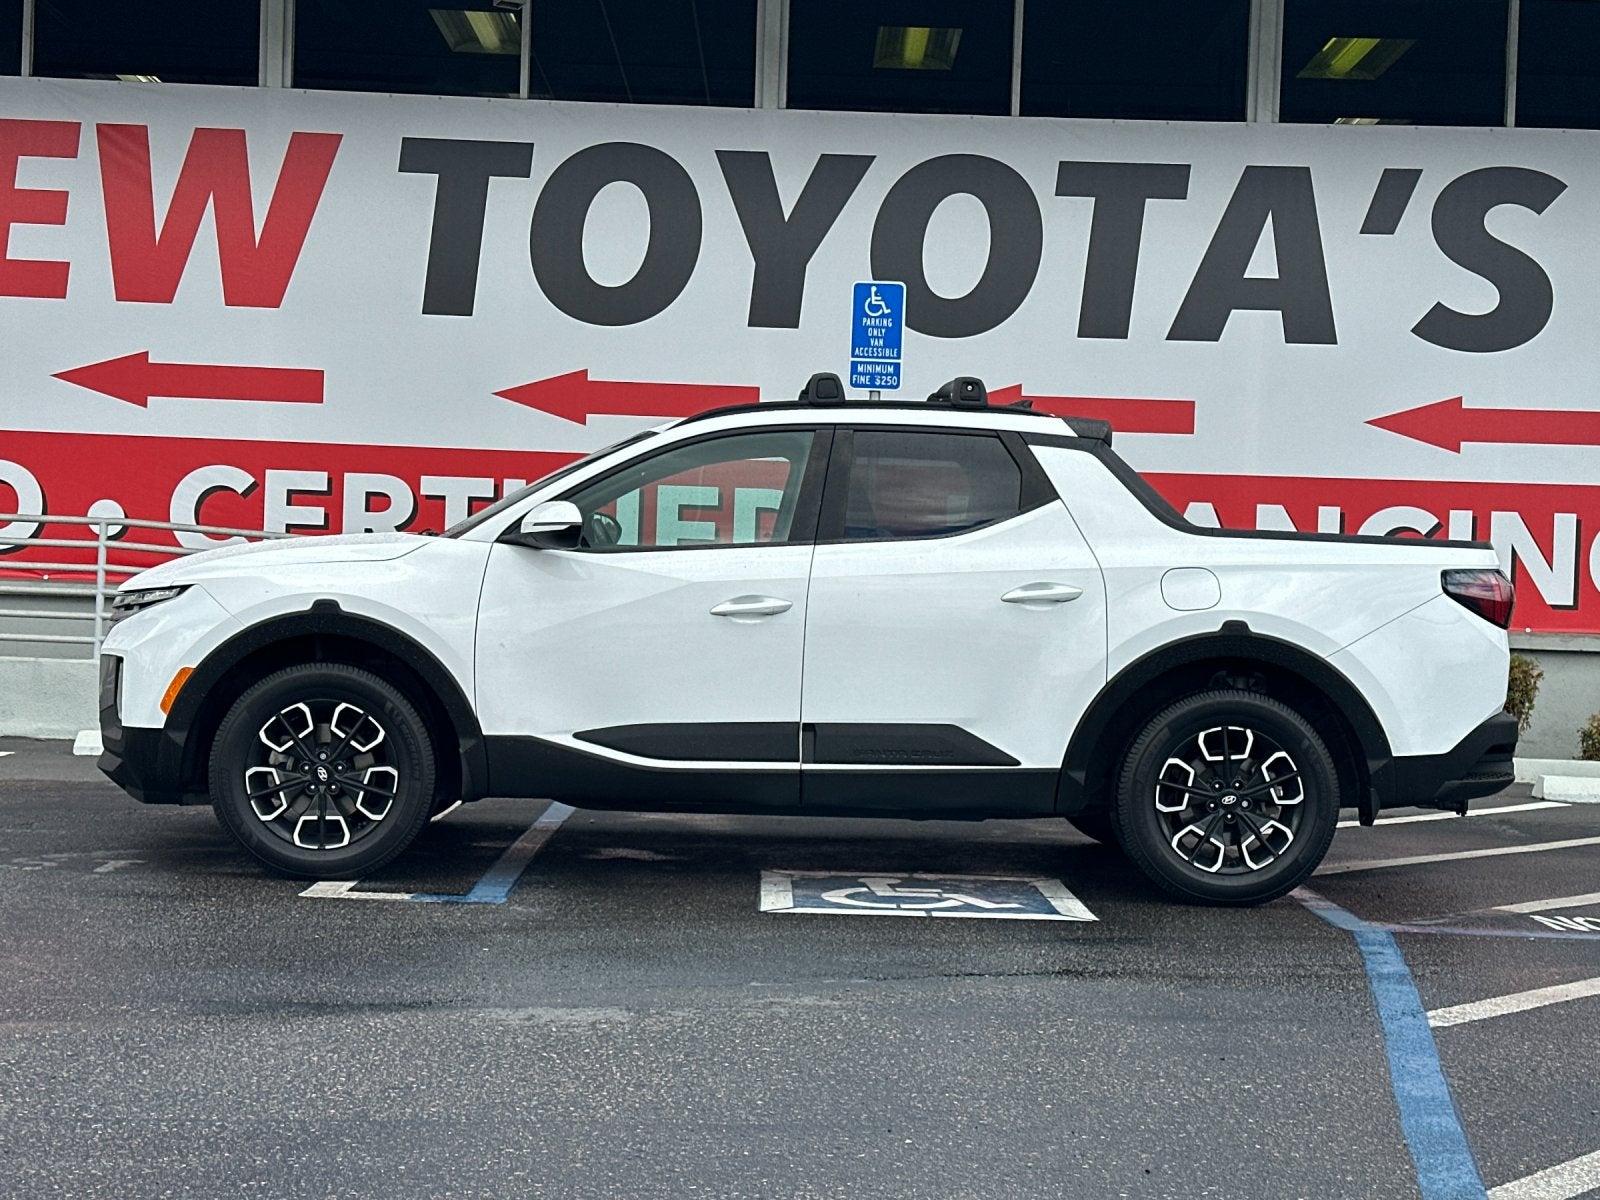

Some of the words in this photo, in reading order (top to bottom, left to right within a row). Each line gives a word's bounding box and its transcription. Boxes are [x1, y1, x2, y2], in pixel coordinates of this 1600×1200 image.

[400, 138, 1567, 352] TOYOTA'S
[863, 317, 893, 327] PARKING
[868, 328, 885, 337] ONLY
[870, 338, 884, 347] VAN
[855, 347, 898, 357] ACCESSIBLE
[858, 364, 894, 374] MINIMUM
[853, 375, 871, 385] FINE
[875, 375, 898, 386] $250
